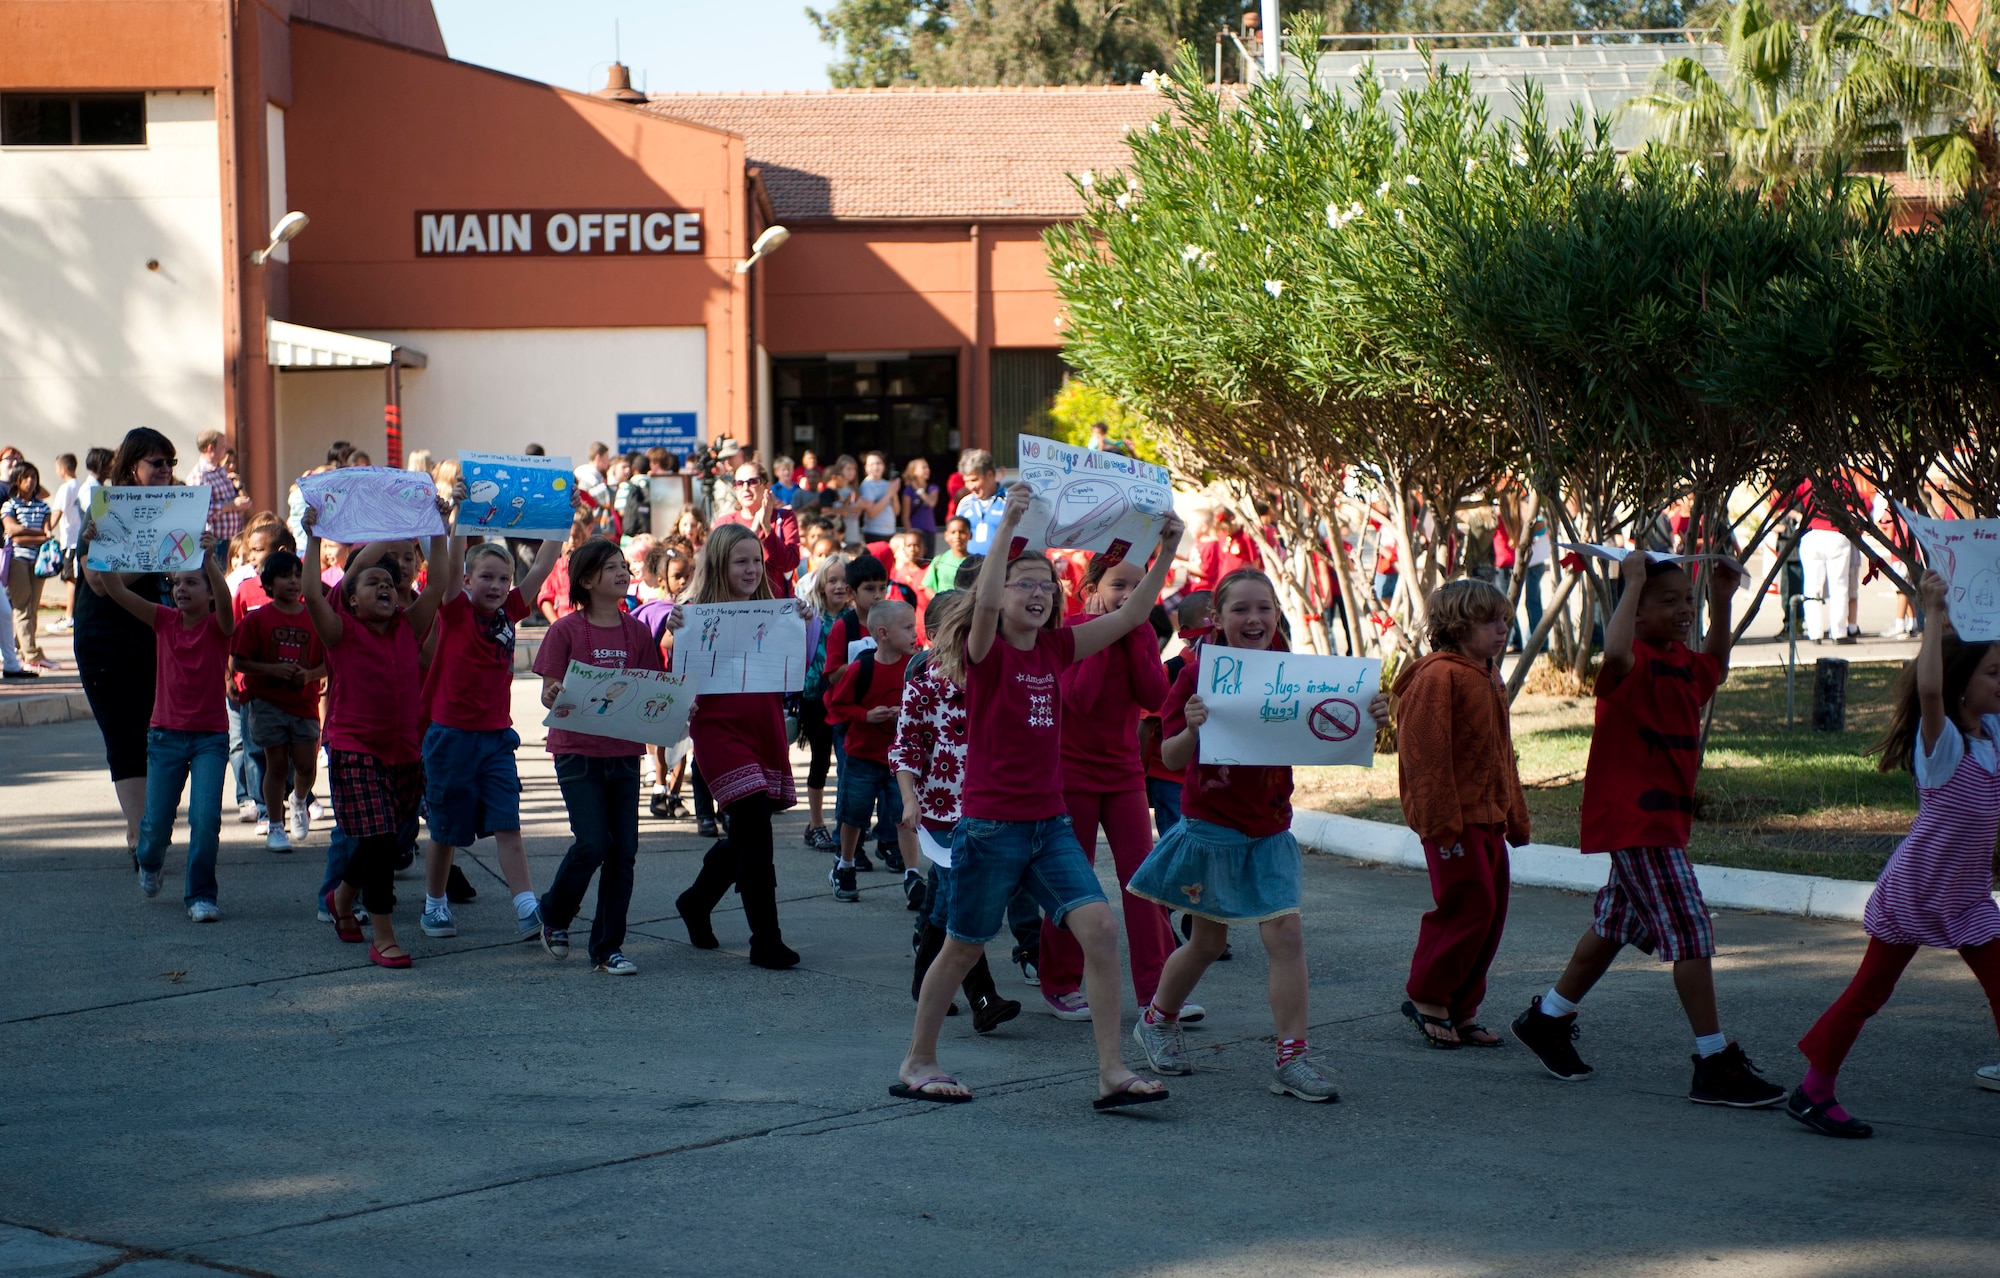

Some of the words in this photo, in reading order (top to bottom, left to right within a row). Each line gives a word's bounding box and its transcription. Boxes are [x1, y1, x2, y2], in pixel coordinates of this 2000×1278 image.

[421, 214, 532, 252] MAIN
[546, 212, 700, 252] OFFICE
[1022, 440, 1040, 458] NO
[1047, 445, 1079, 474] Drugs
[1973, 528, 1998, 540] time
[1212, 656, 1244, 695] Pick
[1307, 680, 1340, 694] instead
[1347, 668, 1367, 694] of
